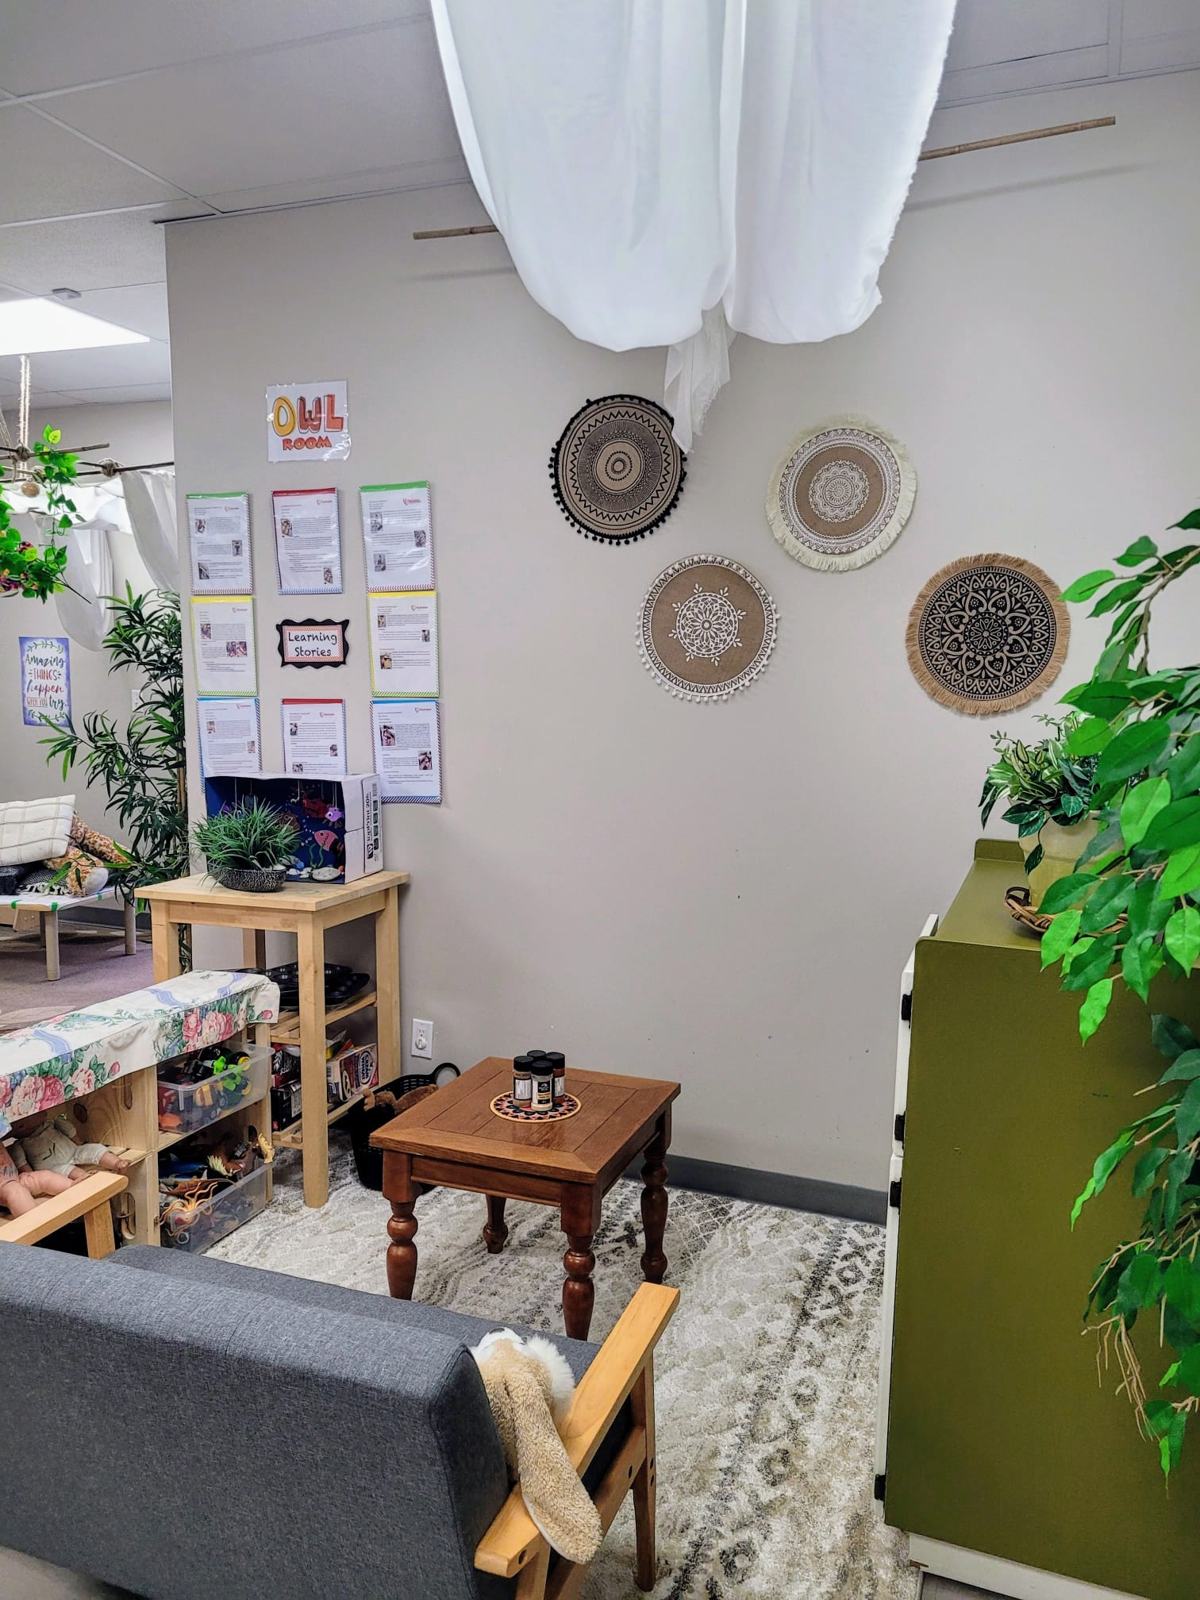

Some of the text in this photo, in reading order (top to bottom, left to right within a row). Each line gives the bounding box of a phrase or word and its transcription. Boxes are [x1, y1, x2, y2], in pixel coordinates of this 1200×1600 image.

[272, 394, 344, 437] OWL
[282, 435, 332, 450] ROOM
[288, 632, 337, 645] Learning
[295, 647, 331, 657] Stories
[26, 654, 64, 668] Amazing
[33, 668, 57, 681] THINGS
